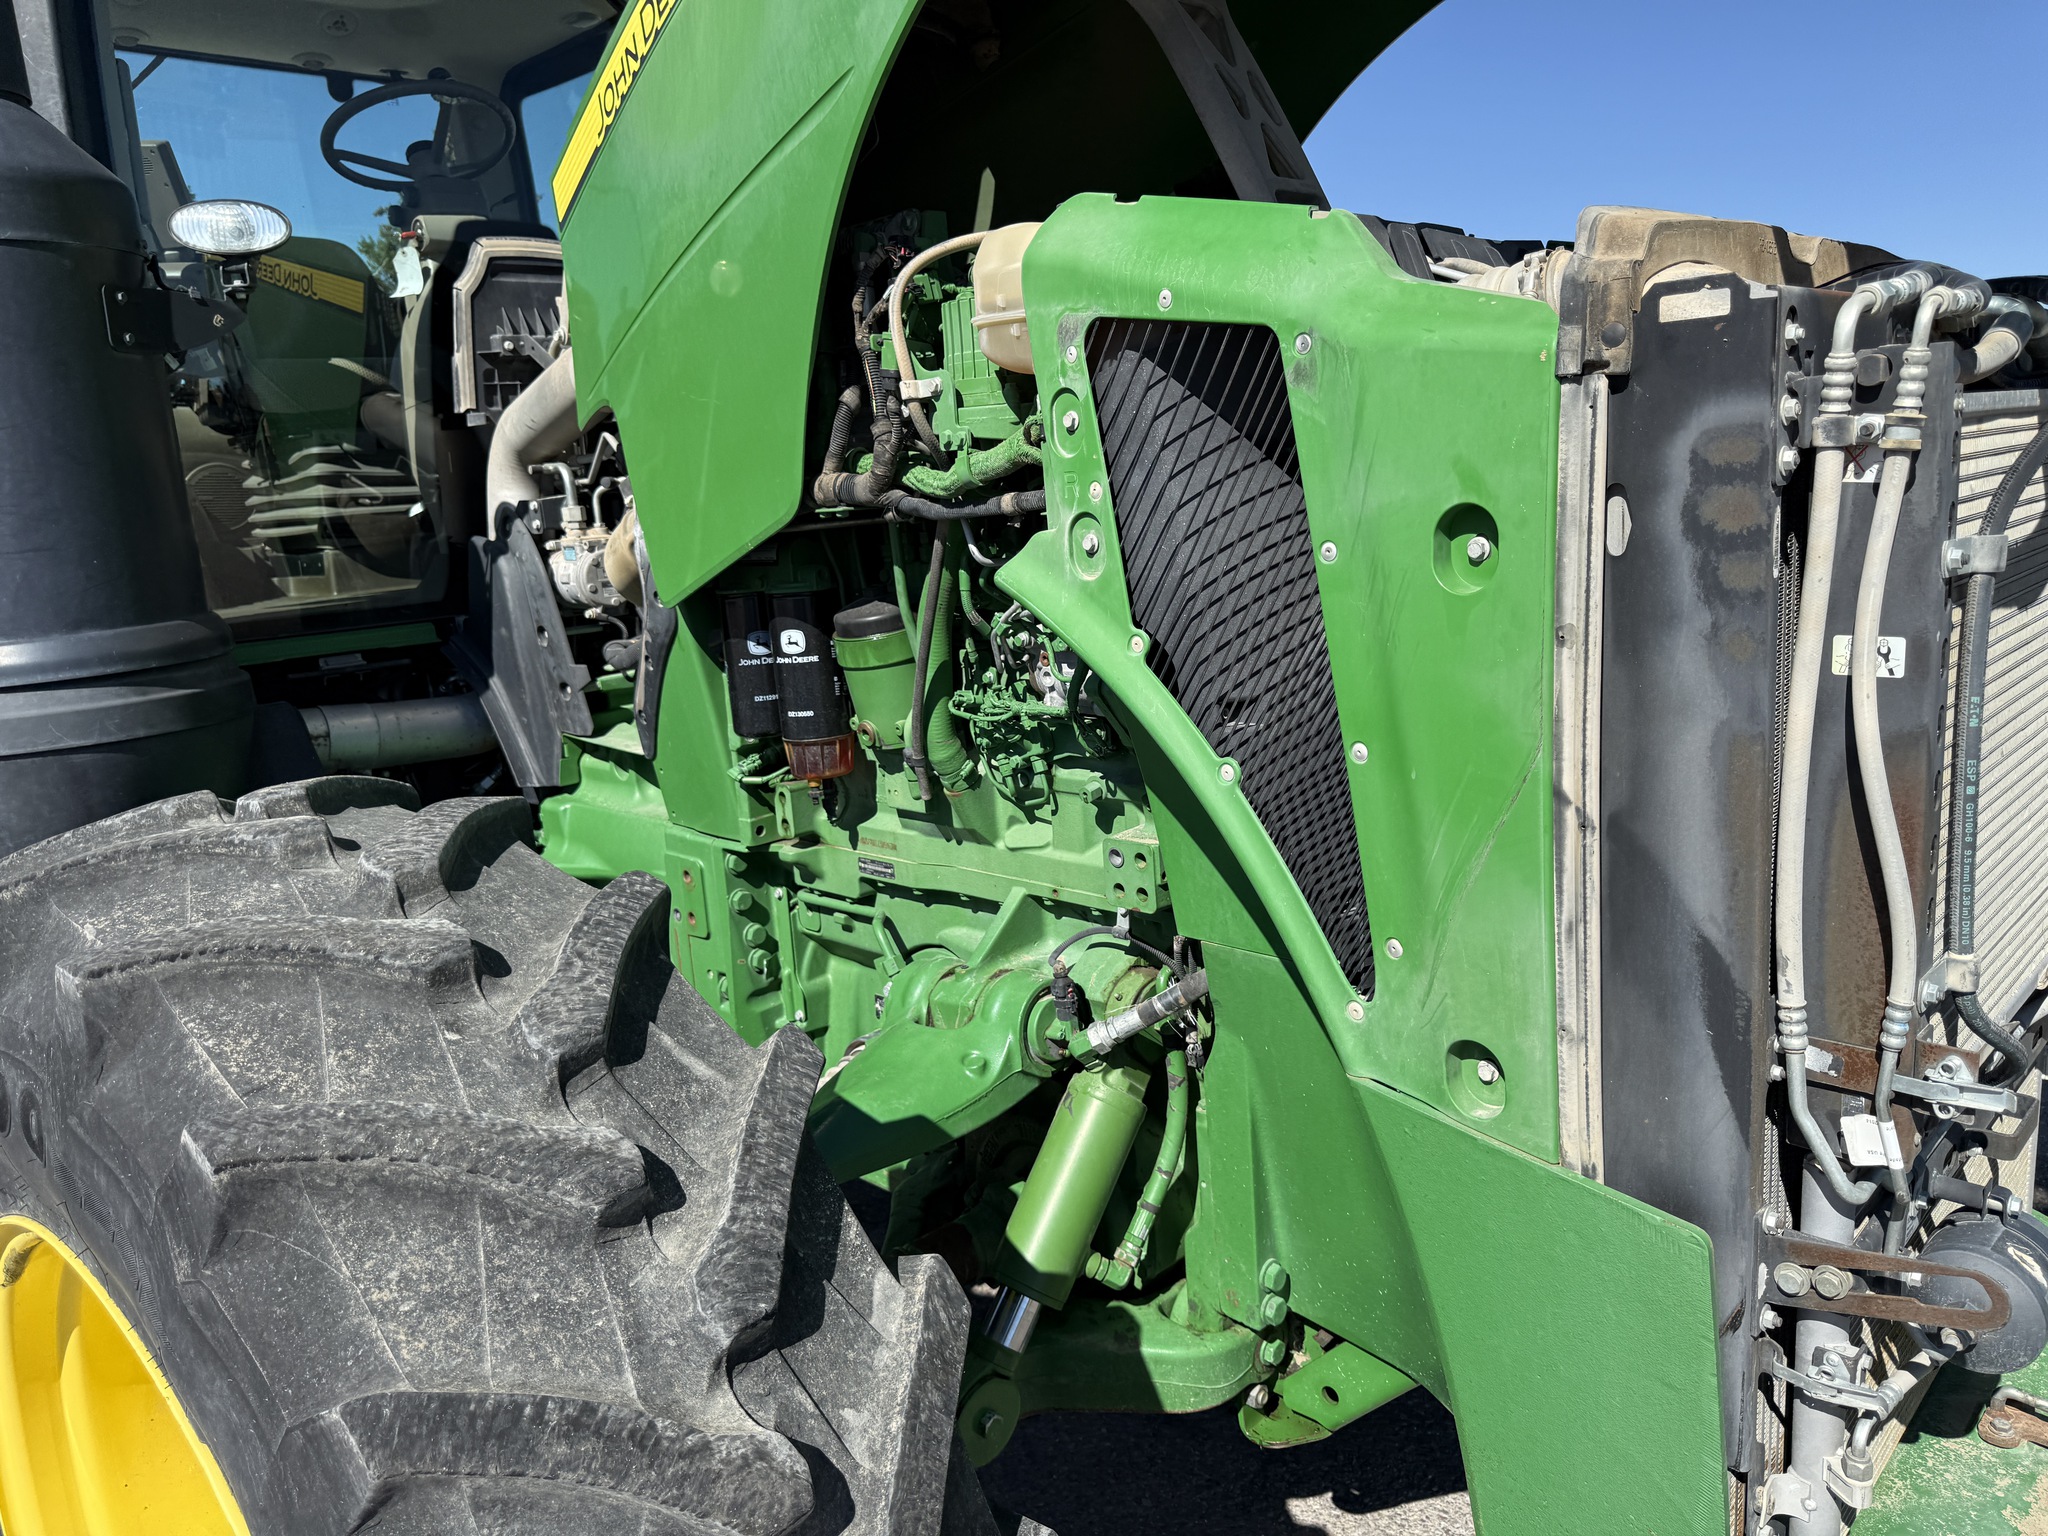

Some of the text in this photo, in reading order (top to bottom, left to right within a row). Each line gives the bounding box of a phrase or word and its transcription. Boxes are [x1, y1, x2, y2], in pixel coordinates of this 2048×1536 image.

[598, 32, 639, 139] JOHN
[738, 658, 761, 666] JOHN
[792, 655, 820, 663] DEERE
[1967, 760, 1977, 782] ESP
[1965, 803, 1975, 842] GH100-6
[1963, 850, 1972, 864] 9.5
[1963, 865, 1971, 882] mm
[1961, 921, 1970, 945] DN10
